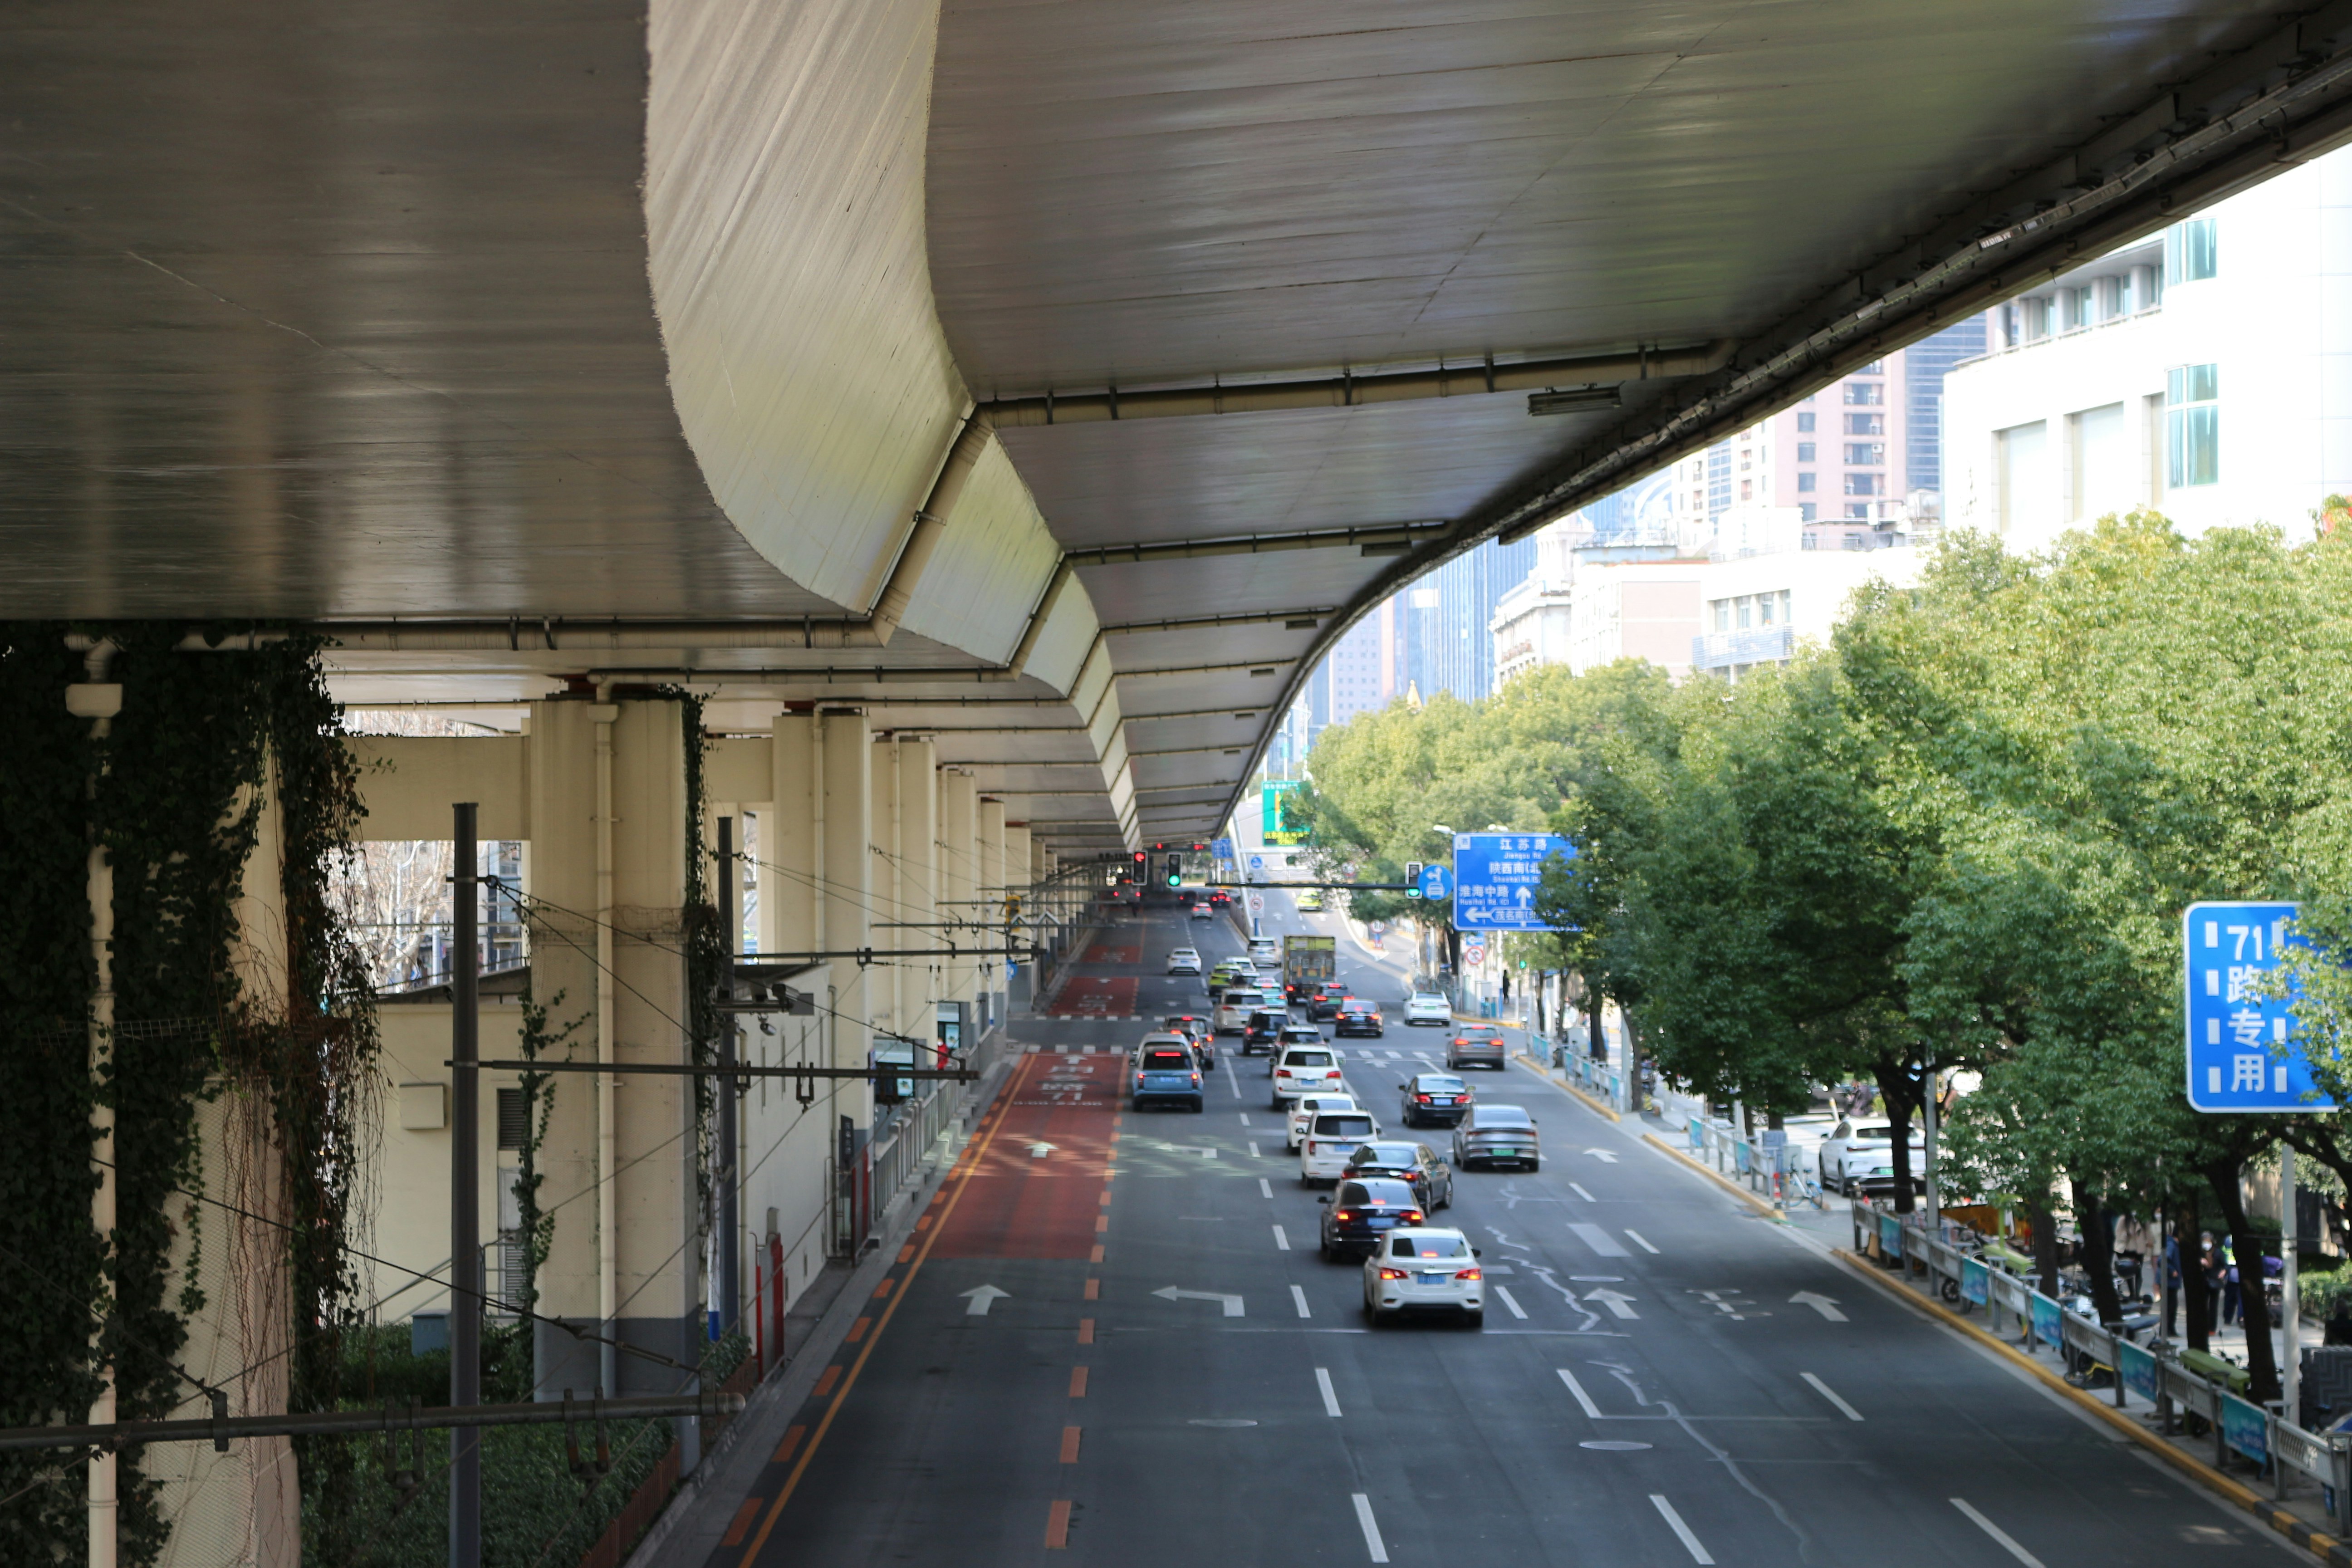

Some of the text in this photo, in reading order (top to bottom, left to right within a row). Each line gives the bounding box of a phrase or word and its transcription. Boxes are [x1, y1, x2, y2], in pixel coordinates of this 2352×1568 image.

[1499, 838, 1547, 851] 江苏路
[1459, 884, 1509, 897] 淮海中路
